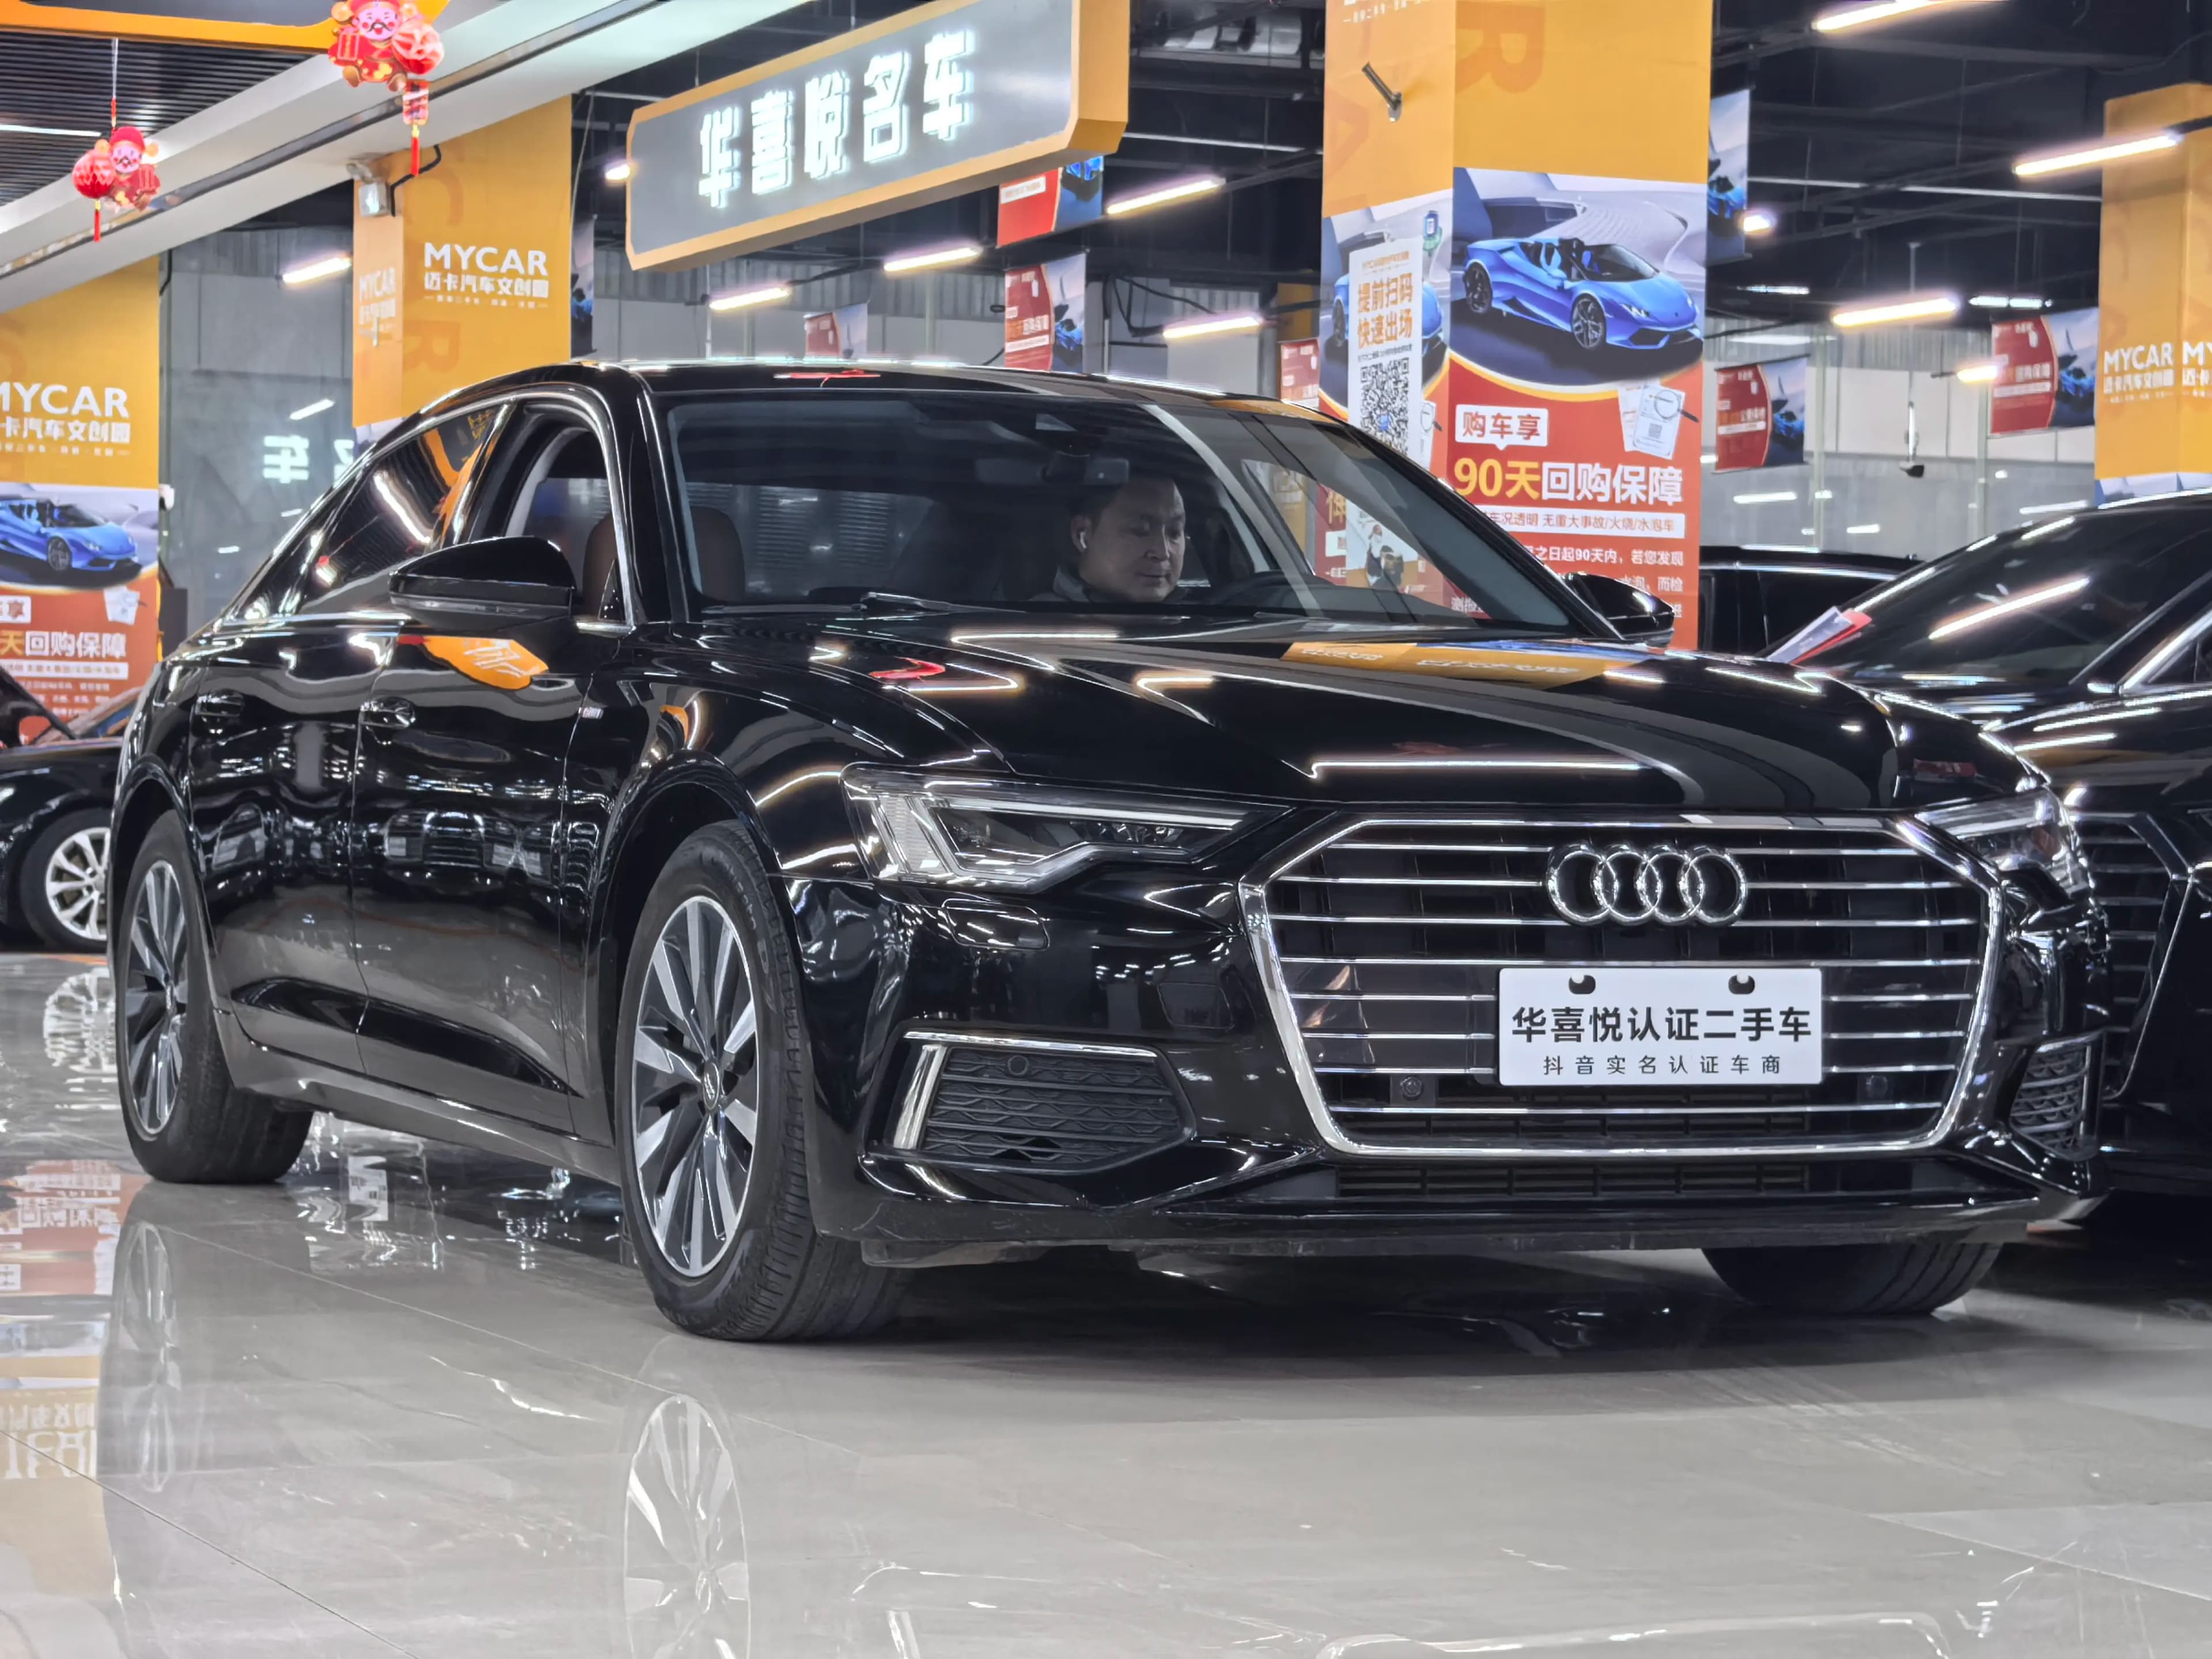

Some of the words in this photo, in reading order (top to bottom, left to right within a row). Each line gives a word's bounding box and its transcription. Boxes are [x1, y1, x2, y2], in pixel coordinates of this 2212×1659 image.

[698, 30, 974, 209] 华喜悦名车
[425, 242, 548, 276] MYCAR
[1358, 272, 1413, 313] 提前扫码
[1358, 309, 1413, 350] 快速出场
[2104, 342, 2174, 374] MYCAR
[2183, 341, 2212, 366] M
[1463, 411, 1541, 440] 购车享
[1454, 457, 1683, 506] 90天回购保障
[1484, 510, 1539, 527] 车况透明
[1512, 1006, 1812, 1043] 华喜悦认证二手车
[1543, 1055, 1781, 1075] 抖音实名认证车商
